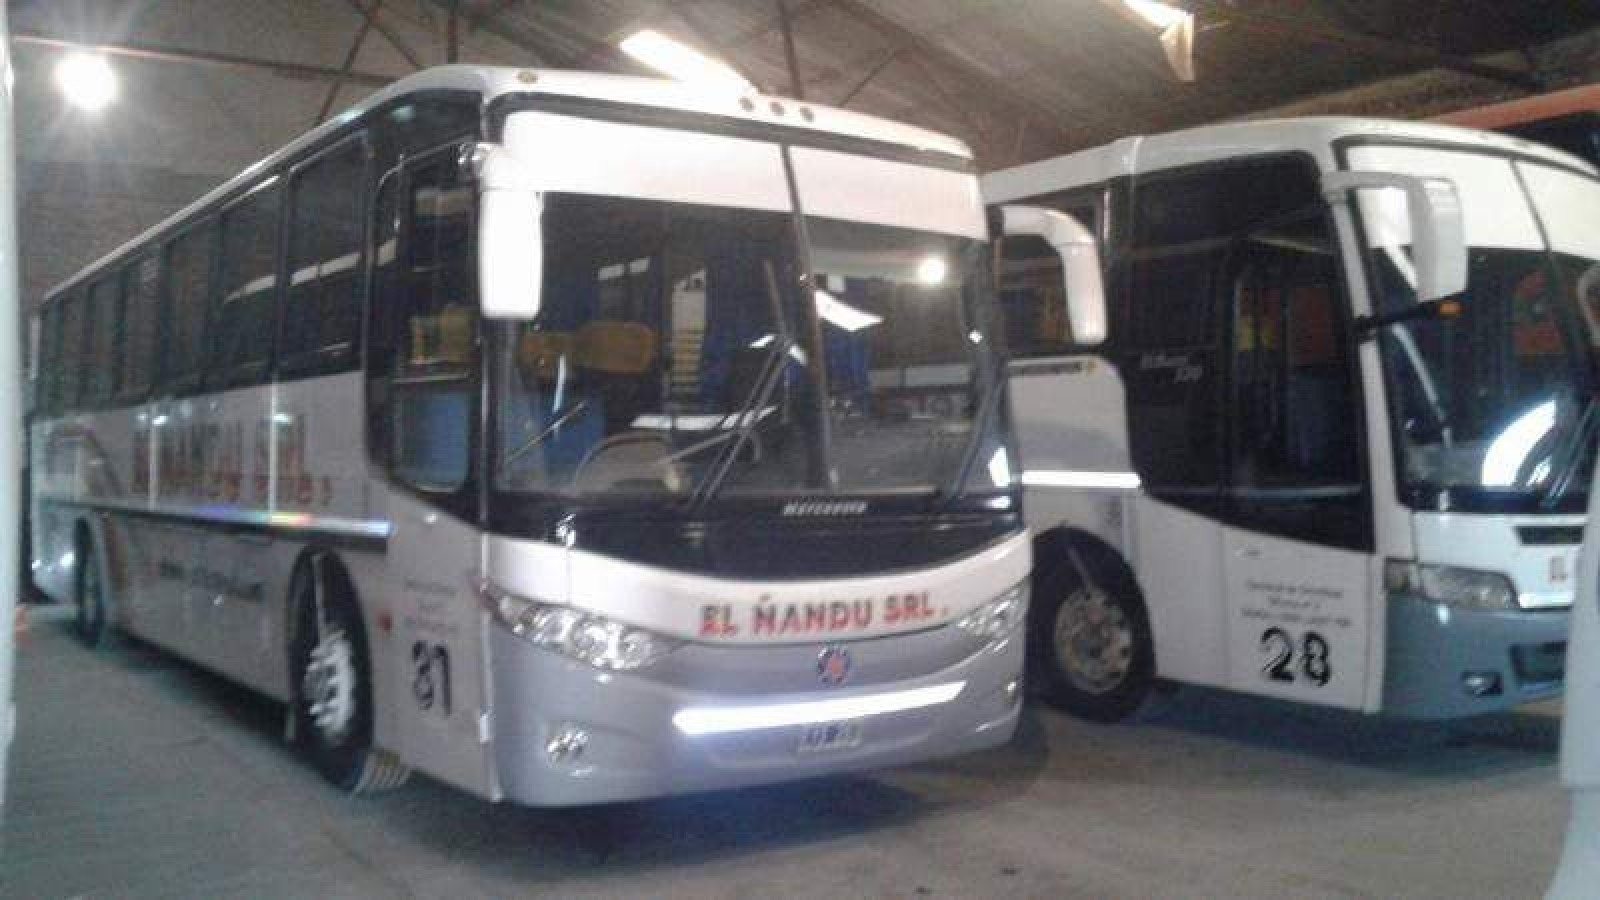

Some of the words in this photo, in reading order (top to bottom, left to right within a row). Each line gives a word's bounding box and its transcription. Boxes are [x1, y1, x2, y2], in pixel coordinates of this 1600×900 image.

[702, 603, 737, 636] EL
[753, 593, 873, 634] ÑANDU
[1260, 626, 1331, 687] 28
